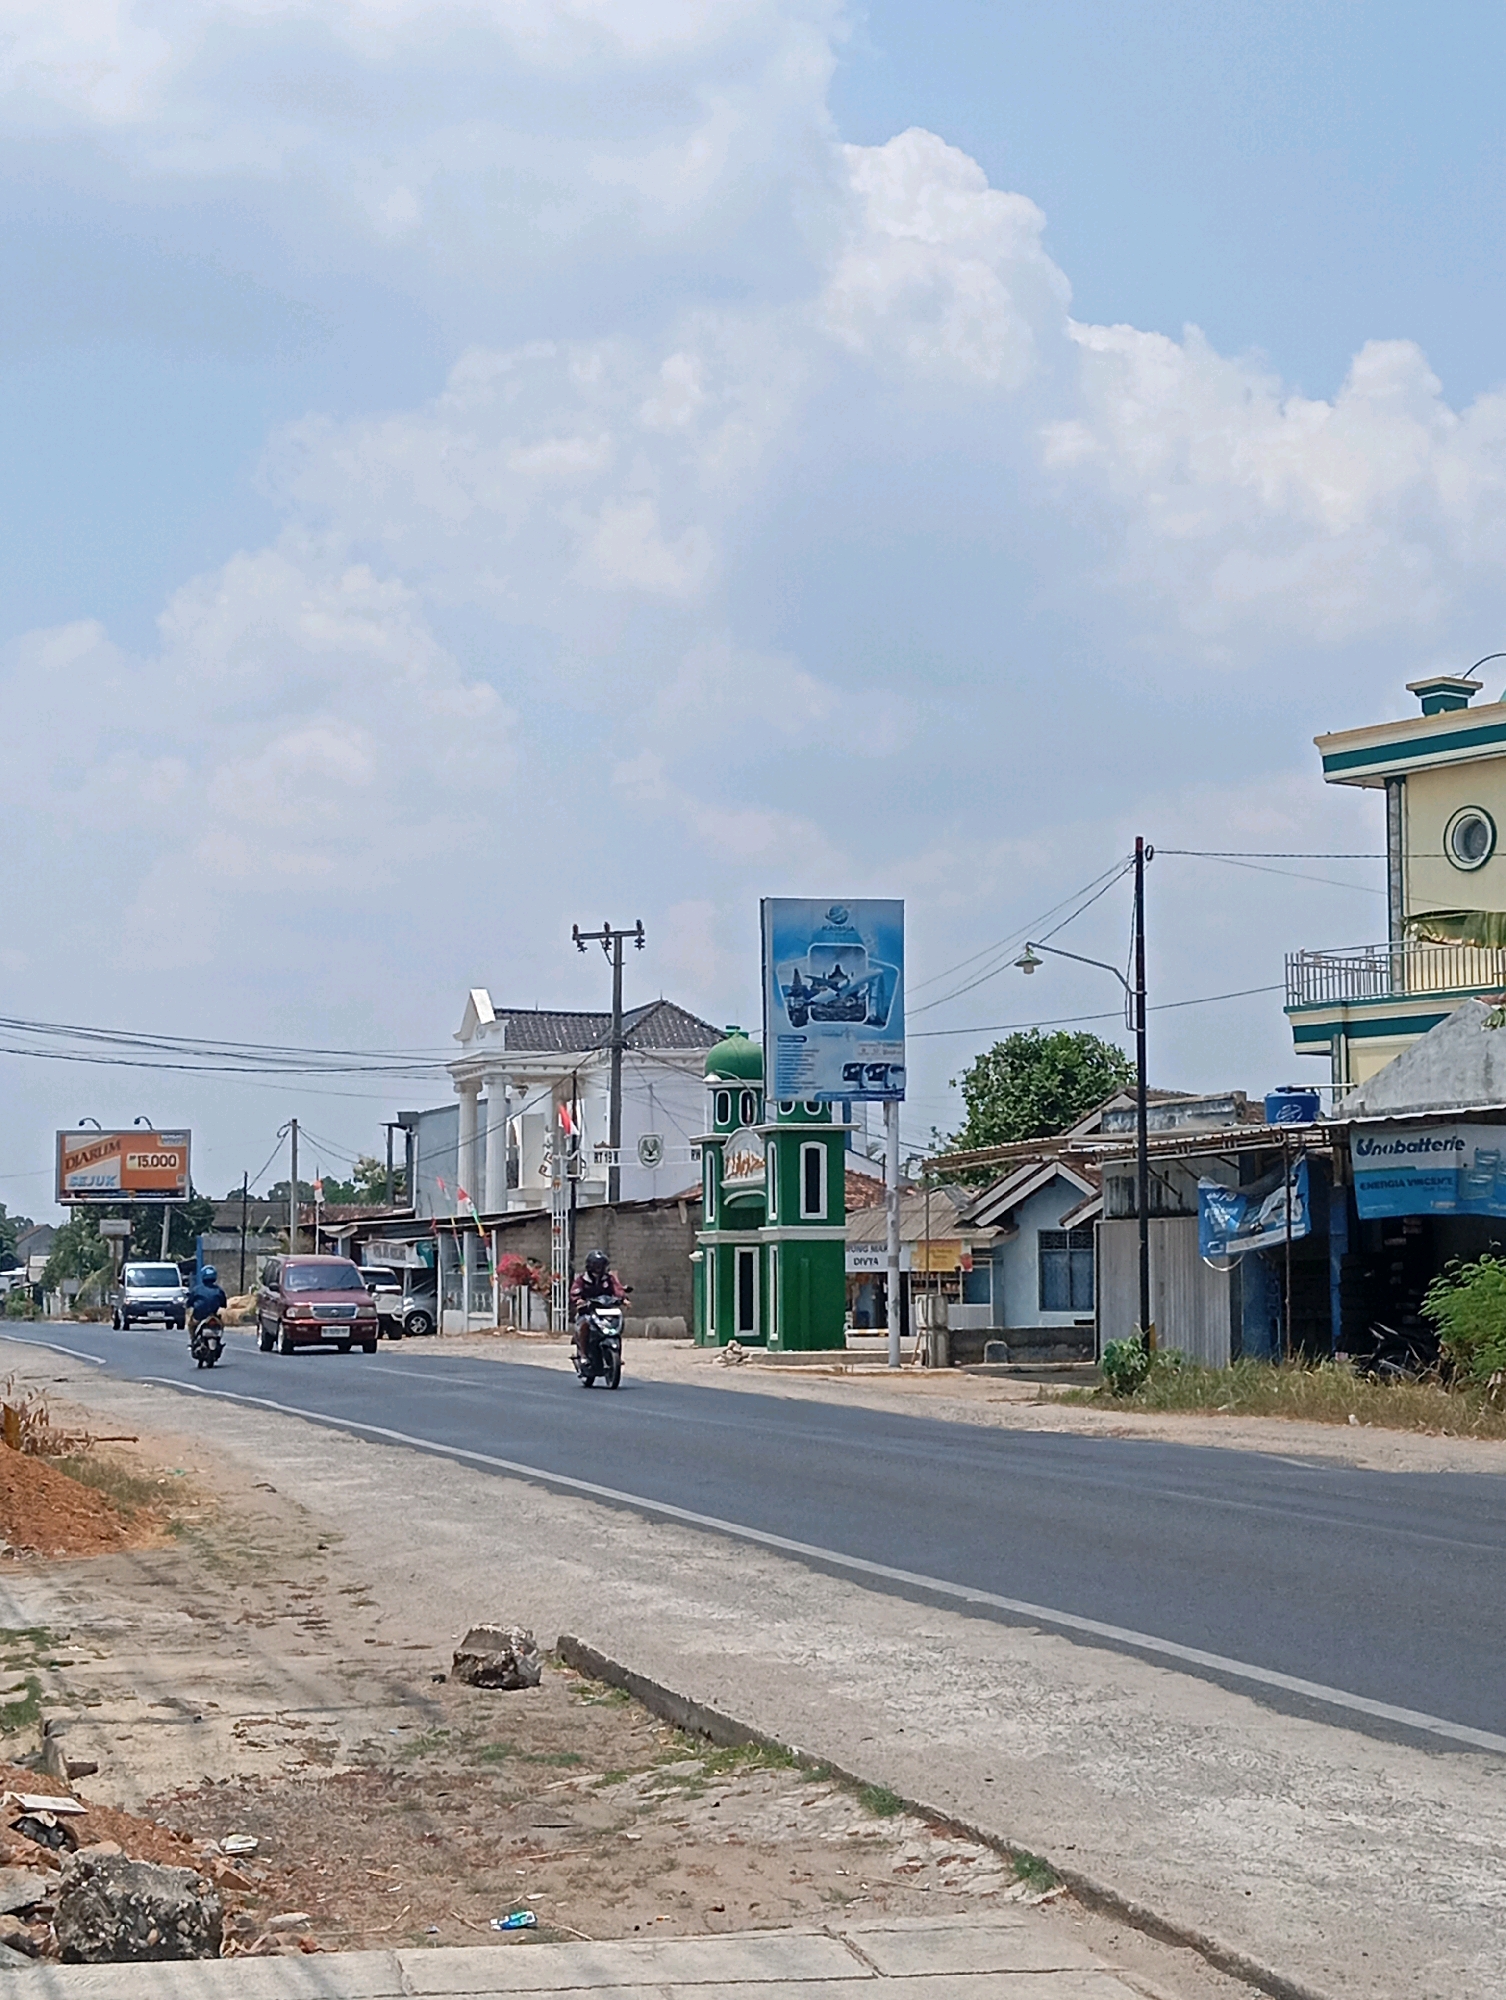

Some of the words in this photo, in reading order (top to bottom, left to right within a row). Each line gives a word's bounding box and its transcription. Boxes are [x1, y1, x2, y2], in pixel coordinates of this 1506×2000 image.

[65, 1140, 121, 1170] DJARUM
[138, 1154, 177, 1168] 15.000
[68, 1174, 118, 1187] SEJUK
